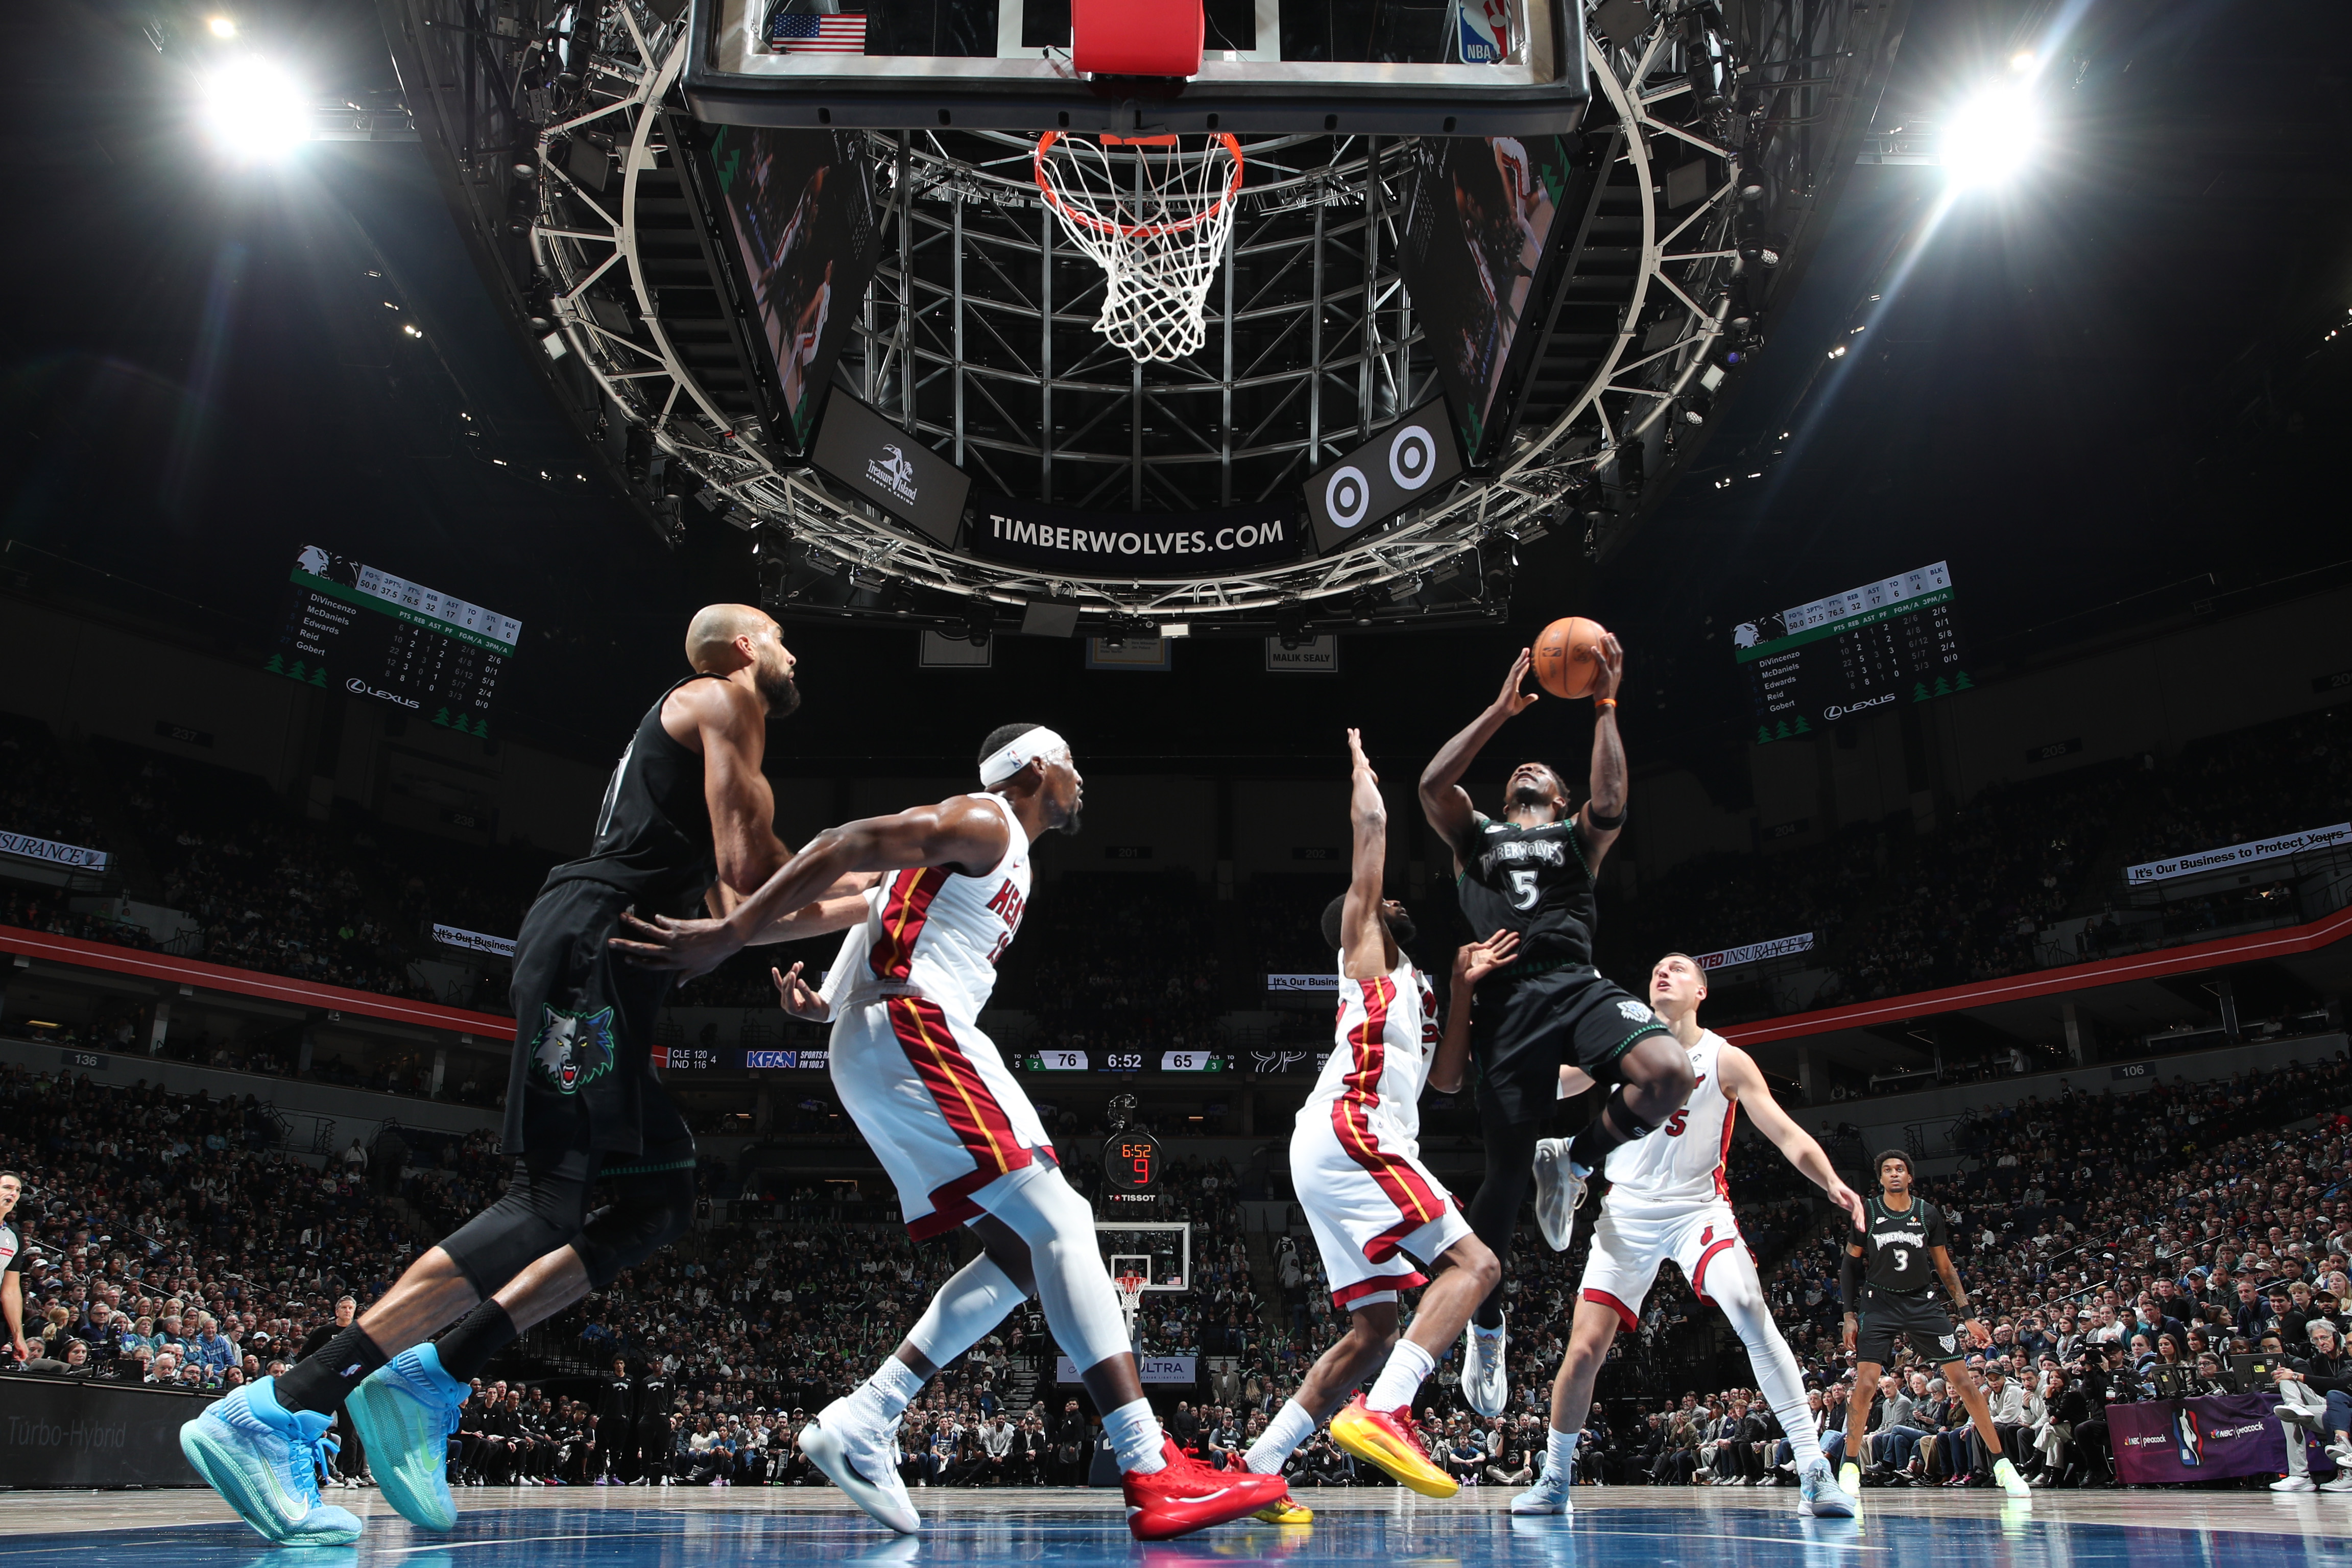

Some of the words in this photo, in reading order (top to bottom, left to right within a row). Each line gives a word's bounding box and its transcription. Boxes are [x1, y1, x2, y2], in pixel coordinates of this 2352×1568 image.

[1467, 44, 1491, 59] NBA
[868, 459, 893, 485] Treasure
[897, 479, 917, 501] Island
[893, 490, 914, 505] CASINO
[990, 514, 1283, 554] TIMBERWOLVES.COM
[360, 580, 377, 591] 50.0
[381, 587, 398, 598] 37.5
[403, 594, 419, 606] 76.5
[425, 603, 435, 612] 32
[365, 571, 380, 581] FG%
[384, 578, 402, 589] 3PT%
[407, 587, 420, 595] FT%
[426, 593, 438, 601] REB
[446, 601, 459, 609] AST
[486, 615, 496, 623] STL
[505, 621, 516, 630] BLK
[1806, 605, 1823, 614] 3PT%
[1867, 586, 1879, 595] AST
[1909, 574, 1921, 582] STL
[1930, 567, 1943, 575] BLK
[1789, 620, 1804, 630] 50.0
[1808, 613, 1823, 624] 37.5
[1828, 607, 1844, 617] 76.5
[1851, 602, 1861, 611] 32
[1871, 596, 1880, 604] 17
[1833, 624, 1845, 632] PTS
[1863, 615, 1875, 623] AST
[1893, 602, 1919, 614] FGM/A
[1923, 593, 1948, 605] 3PM/A
[310, 593, 356, 615] DiVincenzo
[488, 655, 501, 664] 2/6
[399, 611, 411, 619] PTS
[414, 616, 425, 624] REB
[428, 621, 442, 630] AST
[459, 632, 482, 644] FGM/A
[485, 641, 508, 654] 3PM/A
[1759, 652, 1800, 668] DiVincenzo
[1932, 606, 1947, 616] 2/6
[303, 617, 339, 635] Edwards
[482, 677, 495, 687] 5/8
[307, 605, 349, 625] McDaniels
[485, 666, 497, 676] 0/1
[1762, 663, 1799, 679] McDaniels
[1935, 618, 1949, 628] 0/1
[300, 629, 320, 641] Reid
[478, 688, 492, 697] 2/4
[1273, 653, 1301, 663] MALIK
[1303, 653, 1330, 663] SEALY
[1764, 676, 1796, 690] Edwards
[1938, 630, 1952, 639] 5/8
[296, 641, 325, 656] Gobert
[475, 699, 488, 709] 0/0
[1767, 690, 1784, 701] Reid
[1940, 641, 1955, 652] 2/4
[2331, 673, 2352, 687] 20
[1769, 699, 1795, 712] Gobert
[1943, 654, 1958, 663] 0/0
[367, 686, 420, 709] LEXUS
[1843, 693, 1895, 713] LEXUS
[172, 727, 198, 741] 237
[2042, 743, 2067, 758] 205
[453, 815, 475, 828] 238
[1775, 823, 1796, 837] 204
[0, 833, 83, 864] SURANCE
[1118, 848, 1138, 858] 201
[1305, 849, 1326, 859] 202
[2135, 867, 2153, 879] It's
[2155, 861, 2177, 874] Our
[2180, 850, 2236, 870] Business
[2238, 848, 2252, 857] to
[2255, 837, 2303, 855] Protect
[2307, 829, 2344, 845] Yours
[1509, 869, 1539, 910] 5
[438, 928, 452, 940] It's
[455, 932, 472, 944] Our
[474, 936, 516, 953] Business
[1725, 938, 1796, 966] INSURANCE
[1273, 978, 1288, 987] It's
[1290, 978, 1306, 987] Our
[1308, 977, 1339, 987] Busine
[75, 1054, 98, 1067] 136
[672, 1059, 689, 1069] IND
[693, 1060, 706, 1069] 116
[673, 1050, 690, 1059] CLE
[694, 1050, 707, 1059] 120
[710, 1055, 716, 1064] 4
[747, 1050, 796, 1068] KFAN
[799, 1060, 808, 1069] FM
[808, 1060, 824, 1069] 100.3
[800, 1051, 822, 1059] SPORTS
[1058, 1053, 1076, 1066] 76
[1108, 1054, 1142, 1068] 6:52
[1173, 1054, 1192, 1068] 65
[2123, 1065, 2144, 1076] 106
[1665, 1109, 1690, 1137] 5
[1122, 1144, 1151, 1157] 6:52
[1134, 1159, 1148, 1184] 9
[1871, 1230, 1925, 1251] TIMBERWOLVES
[1893, 1248, 1909, 1272] 3
[2131, 1437, 2140, 1445] NBC
[2143, 1434, 2166, 1448] peacock
[2220, 1429, 2233, 1438] NBC
[2236, 1421, 2265, 1439] peacock
